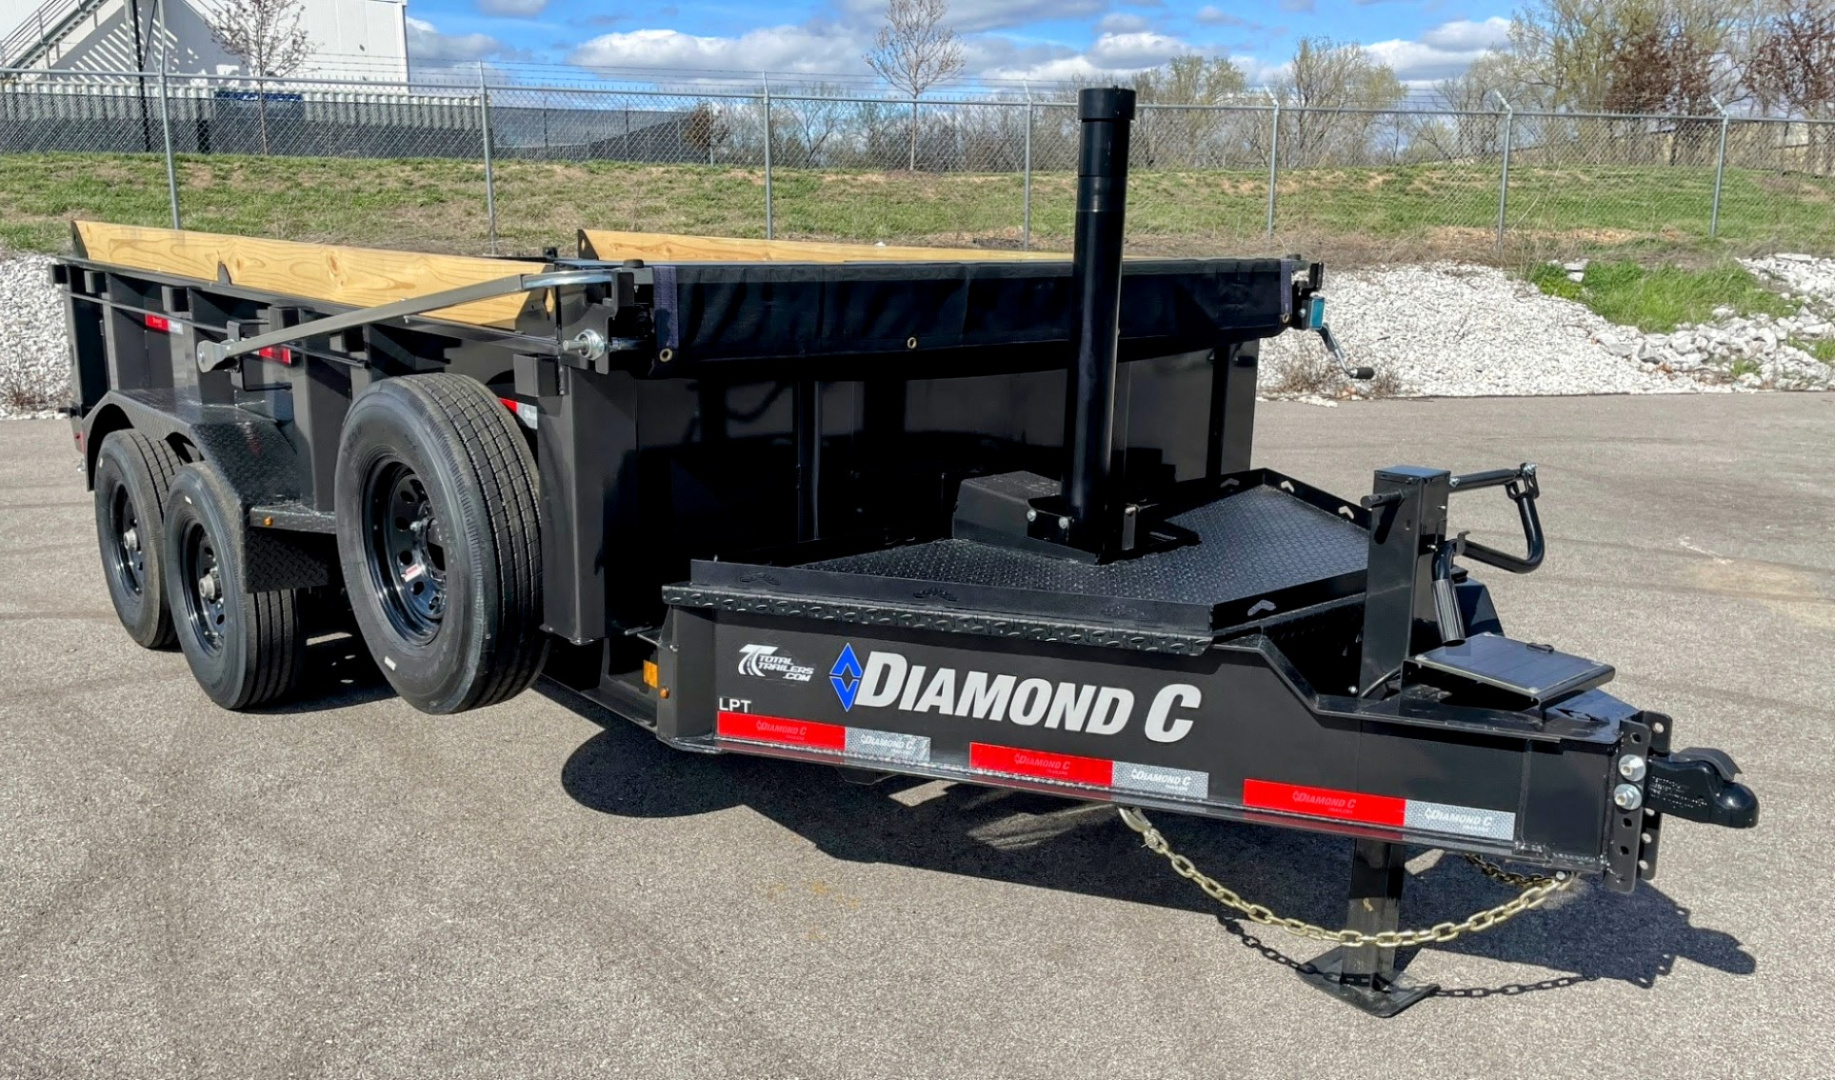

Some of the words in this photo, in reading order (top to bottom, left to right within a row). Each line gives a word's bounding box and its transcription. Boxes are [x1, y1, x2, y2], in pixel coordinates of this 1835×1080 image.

[758, 662, 814, 674] TRAILERS
[759, 655, 794, 665] TOTAL
[782, 673, 812, 682] .COM
[719, 697, 752, 713] LPT
[853, 651, 1135, 735] DIAMOND
[1144, 683, 1202, 743] C
[1298, 792, 1346, 807] DIAMOND
[1347, 799, 1357, 809] C
[1431, 809, 1481, 825] DIAMOND
[1483, 816, 1492, 827] C
